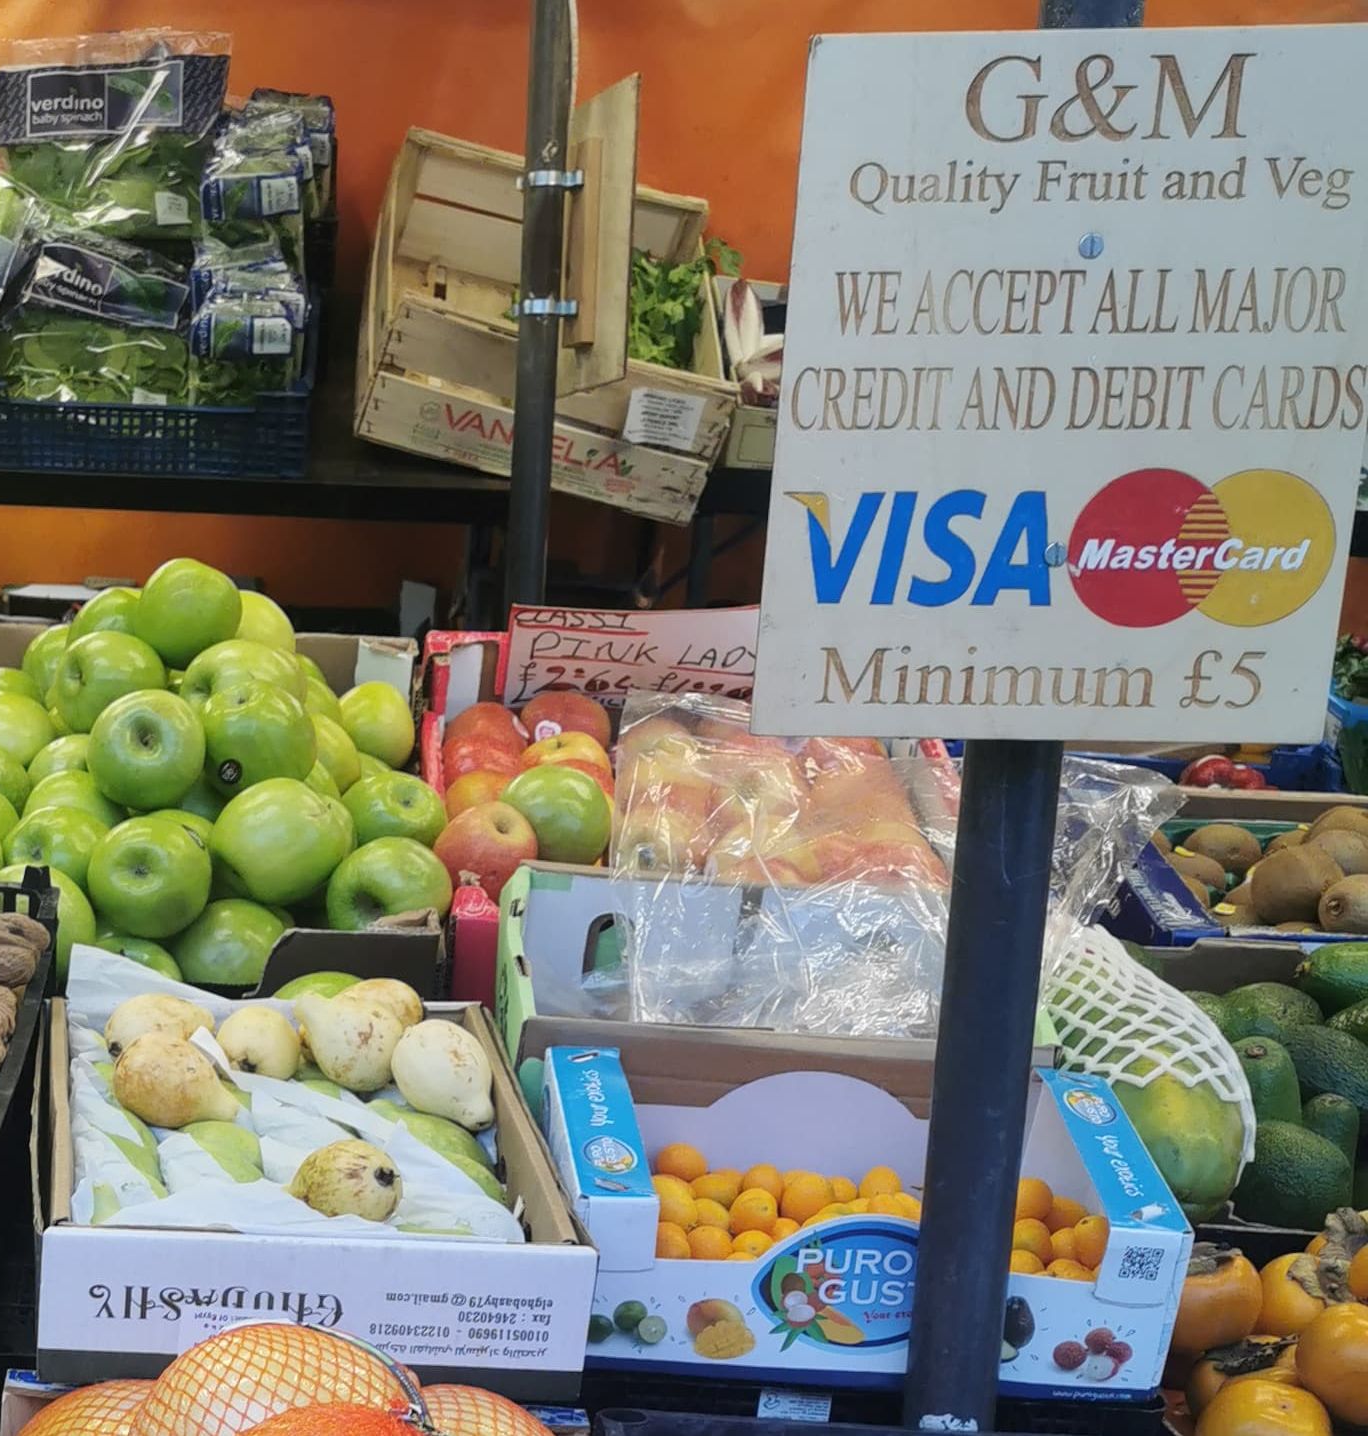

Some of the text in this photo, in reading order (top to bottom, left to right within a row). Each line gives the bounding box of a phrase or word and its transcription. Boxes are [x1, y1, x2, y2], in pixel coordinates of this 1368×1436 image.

[32, 94, 105, 113] verdino
[964, 52, 1257, 143] G&M
[850, 156, 1356, 214] Quality Fruit and Veg
[835, 266, 1348, 336] WE ACCEPT ALL MAJOR
[791, 363, 1367, 432] CREDIT AND DEBIT CARDS
[783, 489, 1310, 608] VISA MasterCard
[529, 631, 659, 664] PINK
[815, 644, 1269, 710] Minimum £5
[797, 1248, 913, 1276] PURO
[818, 1278, 916, 1306] GUS
[369, 1323, 450, 1338] 01223409218
[458, 1311, 517, 1326] 24640230
[531, 1313, 552, 1326] fax
[468, 1328, 549, 1343] 01005119690
